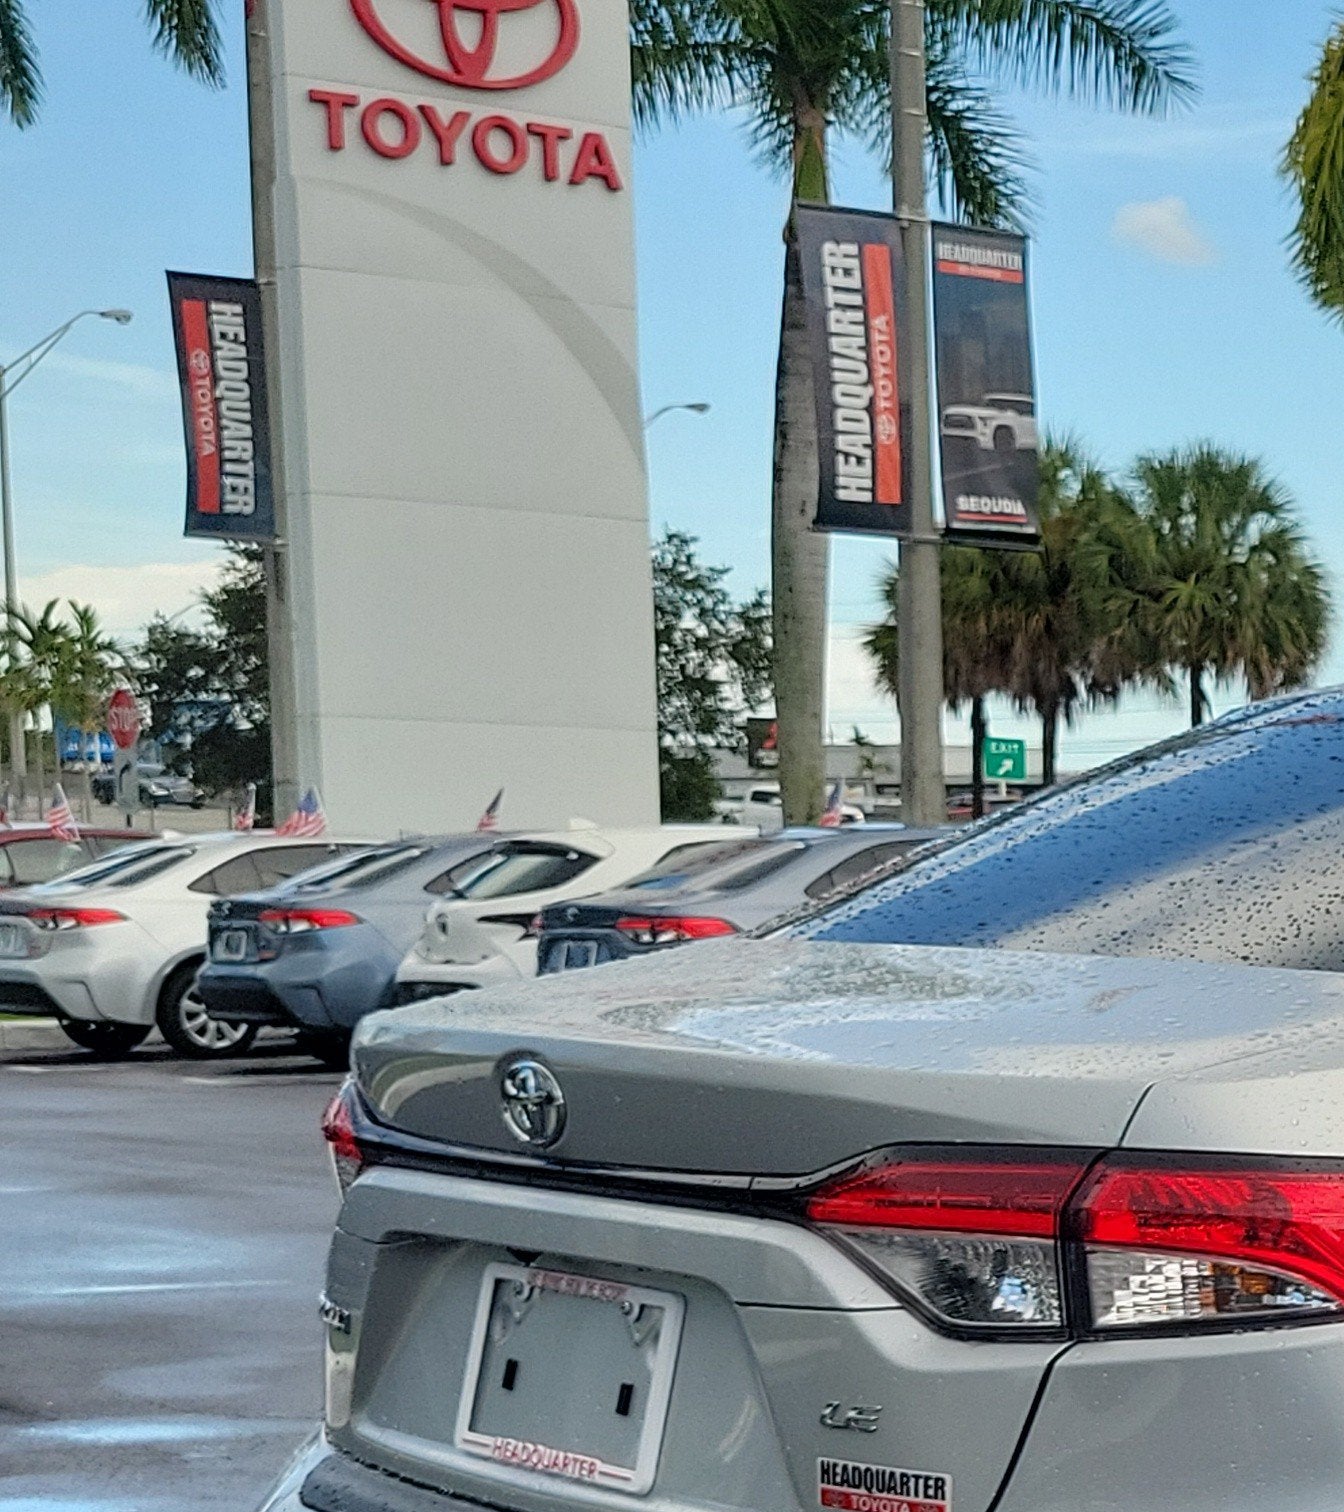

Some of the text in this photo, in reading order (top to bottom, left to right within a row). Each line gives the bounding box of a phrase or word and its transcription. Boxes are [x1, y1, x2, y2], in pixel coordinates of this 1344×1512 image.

[309, 89, 622, 191] TOYOTA
[821, 240, 875, 502] HEADQUARTER
[872, 315, 893, 412] TOYOTA
[197, 377, 216, 457] TOYOTA
[210, 301, 255, 515] HEADQUARTER
[957, 495, 1026, 516] SEQUOIA
[991, 741, 1019, 754] EXIT
[820, 1401, 883, 1432] LE
[493, 1438, 598, 1478] HEADQUARTER
[820, 1460, 946, 1501] HEADQUARTER
